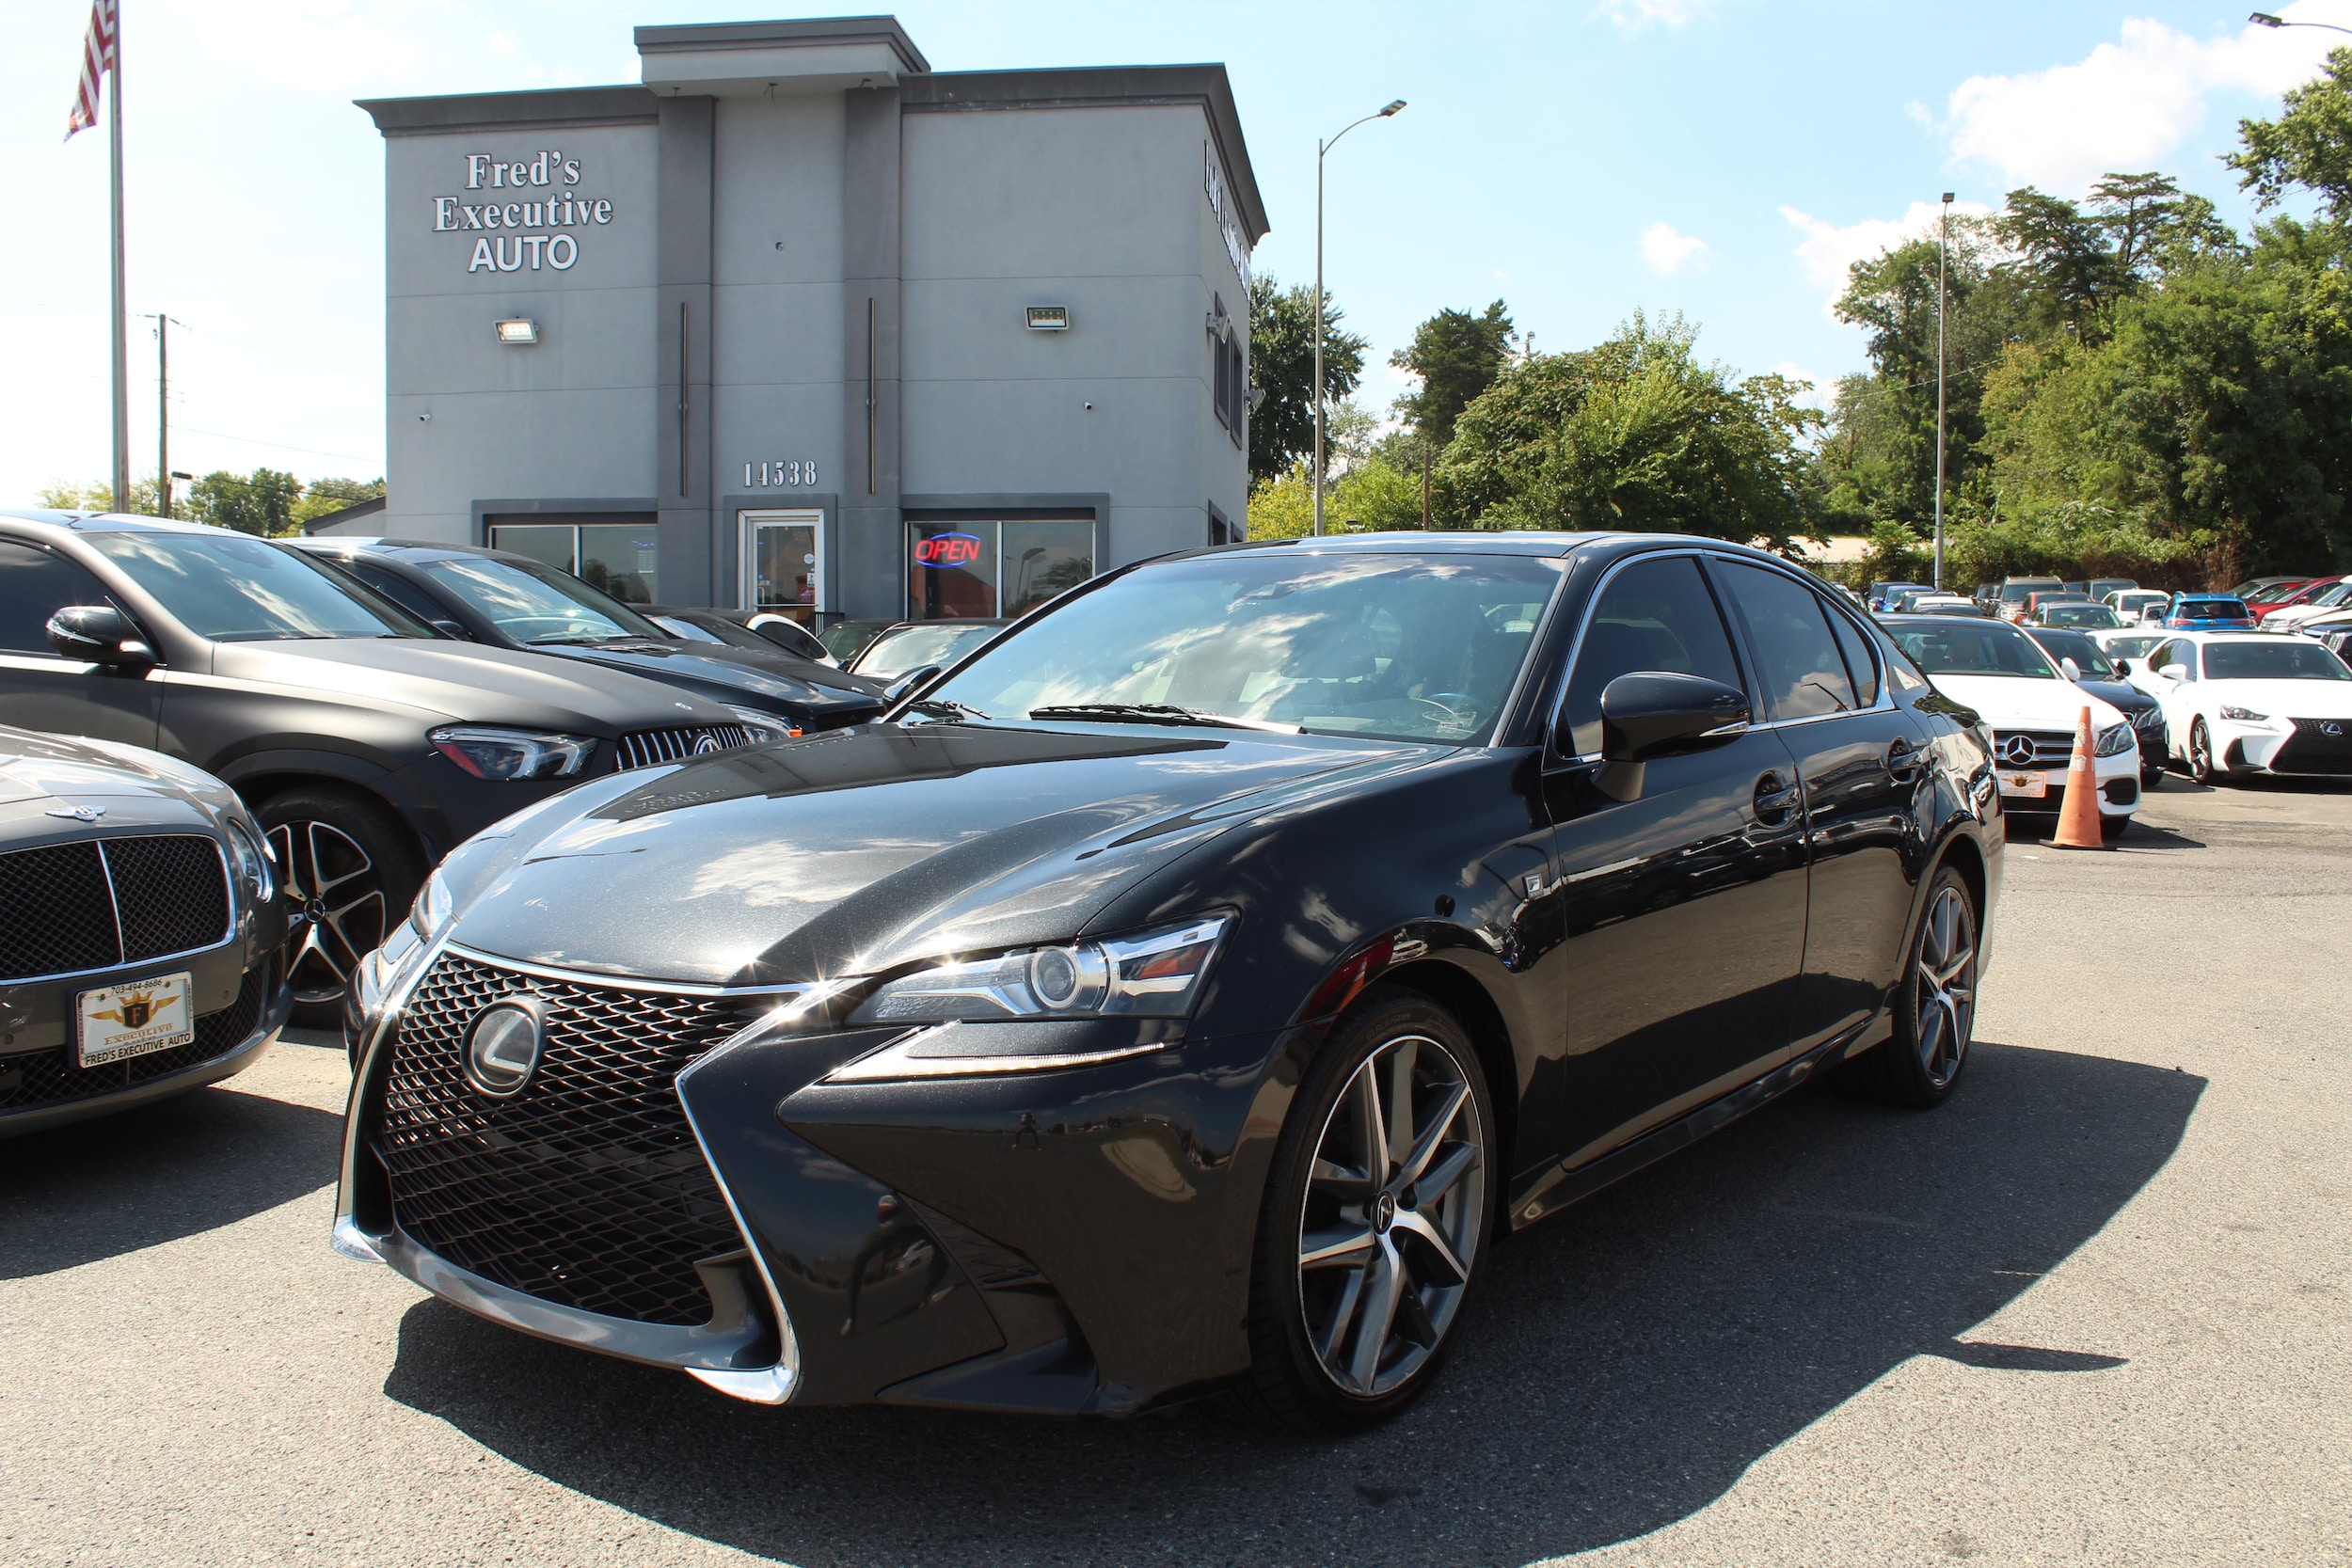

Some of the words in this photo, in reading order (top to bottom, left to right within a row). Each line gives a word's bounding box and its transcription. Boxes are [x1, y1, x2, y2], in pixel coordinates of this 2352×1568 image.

[465, 150, 580, 189] Fred's
[432, 191, 613, 232] Executive
[468, 233, 579, 273] AUTO
[744, 460, 817, 487] 14538
[914, 539, 981, 561] OPEN
[111, 979, 163, 995] 703-494-8686
[86, 1050, 117, 1065] FRED'S
[119, 1038, 165, 1057] EXECUTIVE
[168, 1033, 190, 1047] AUTO
